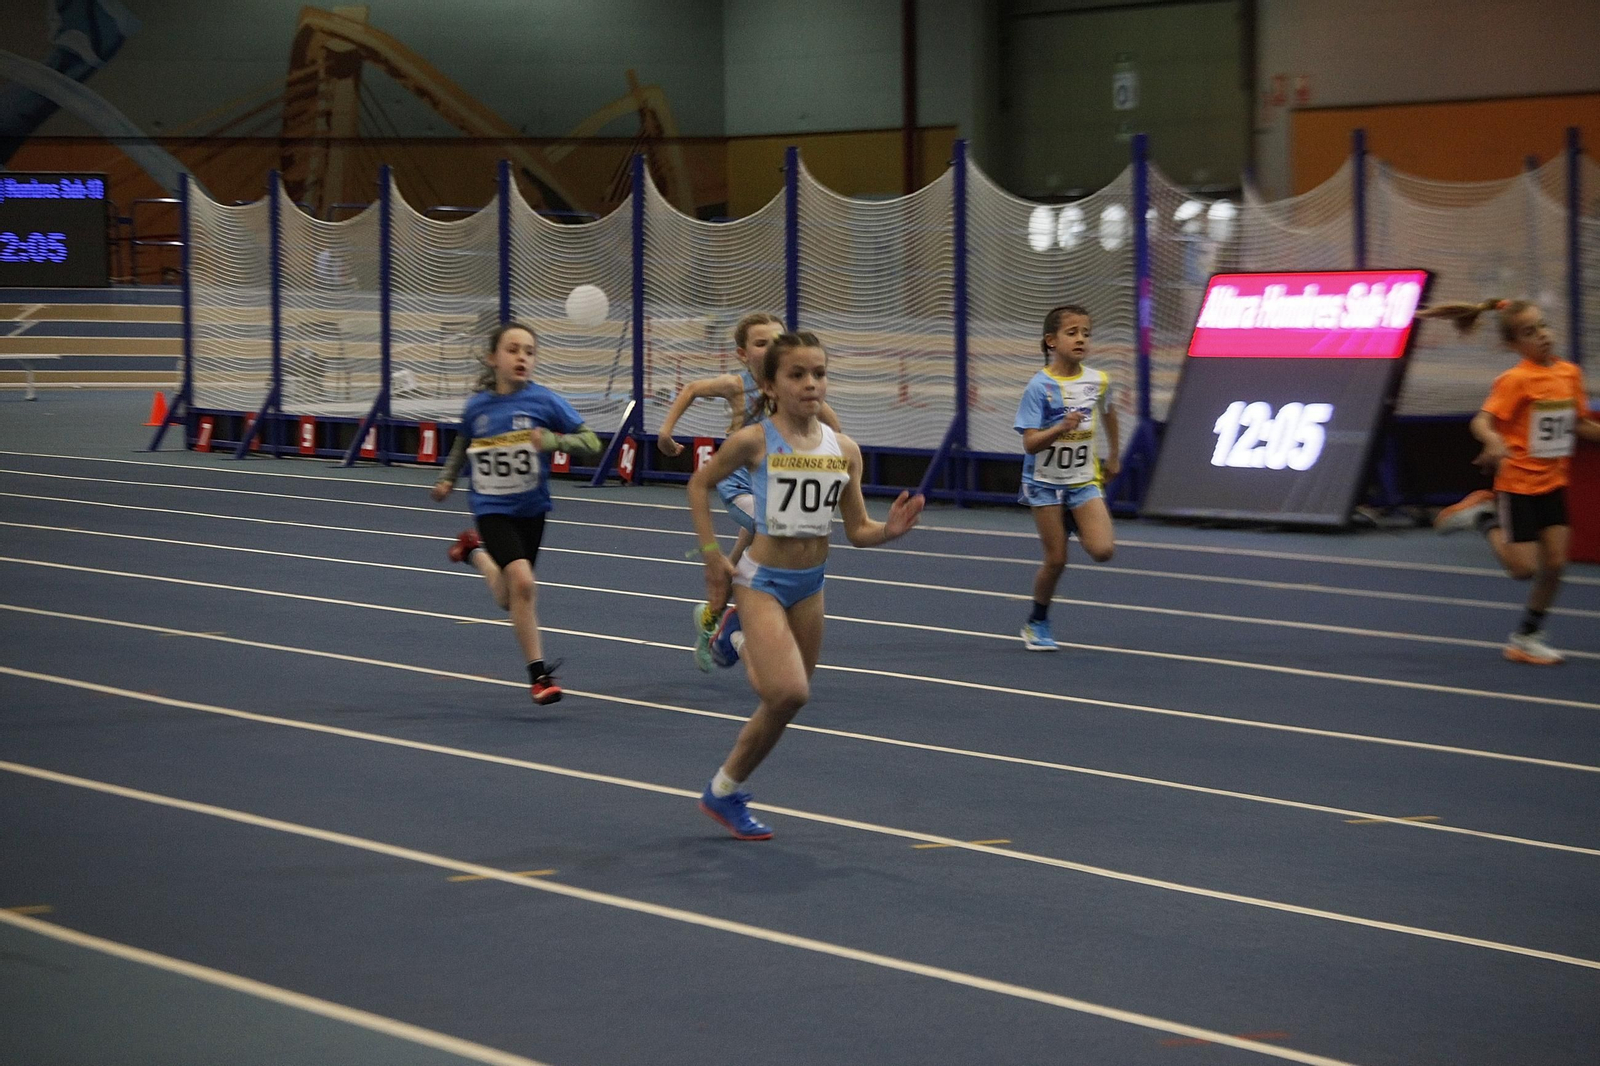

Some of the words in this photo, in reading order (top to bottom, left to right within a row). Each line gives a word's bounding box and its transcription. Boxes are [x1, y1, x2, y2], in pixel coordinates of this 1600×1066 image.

[1210, 401, 1334, 470] 12:05
[476, 449, 531, 477] 563
[771, 457, 823, 469] OURENSE
[1042, 445, 1088, 469] 709
[776, 478, 841, 513] 704
